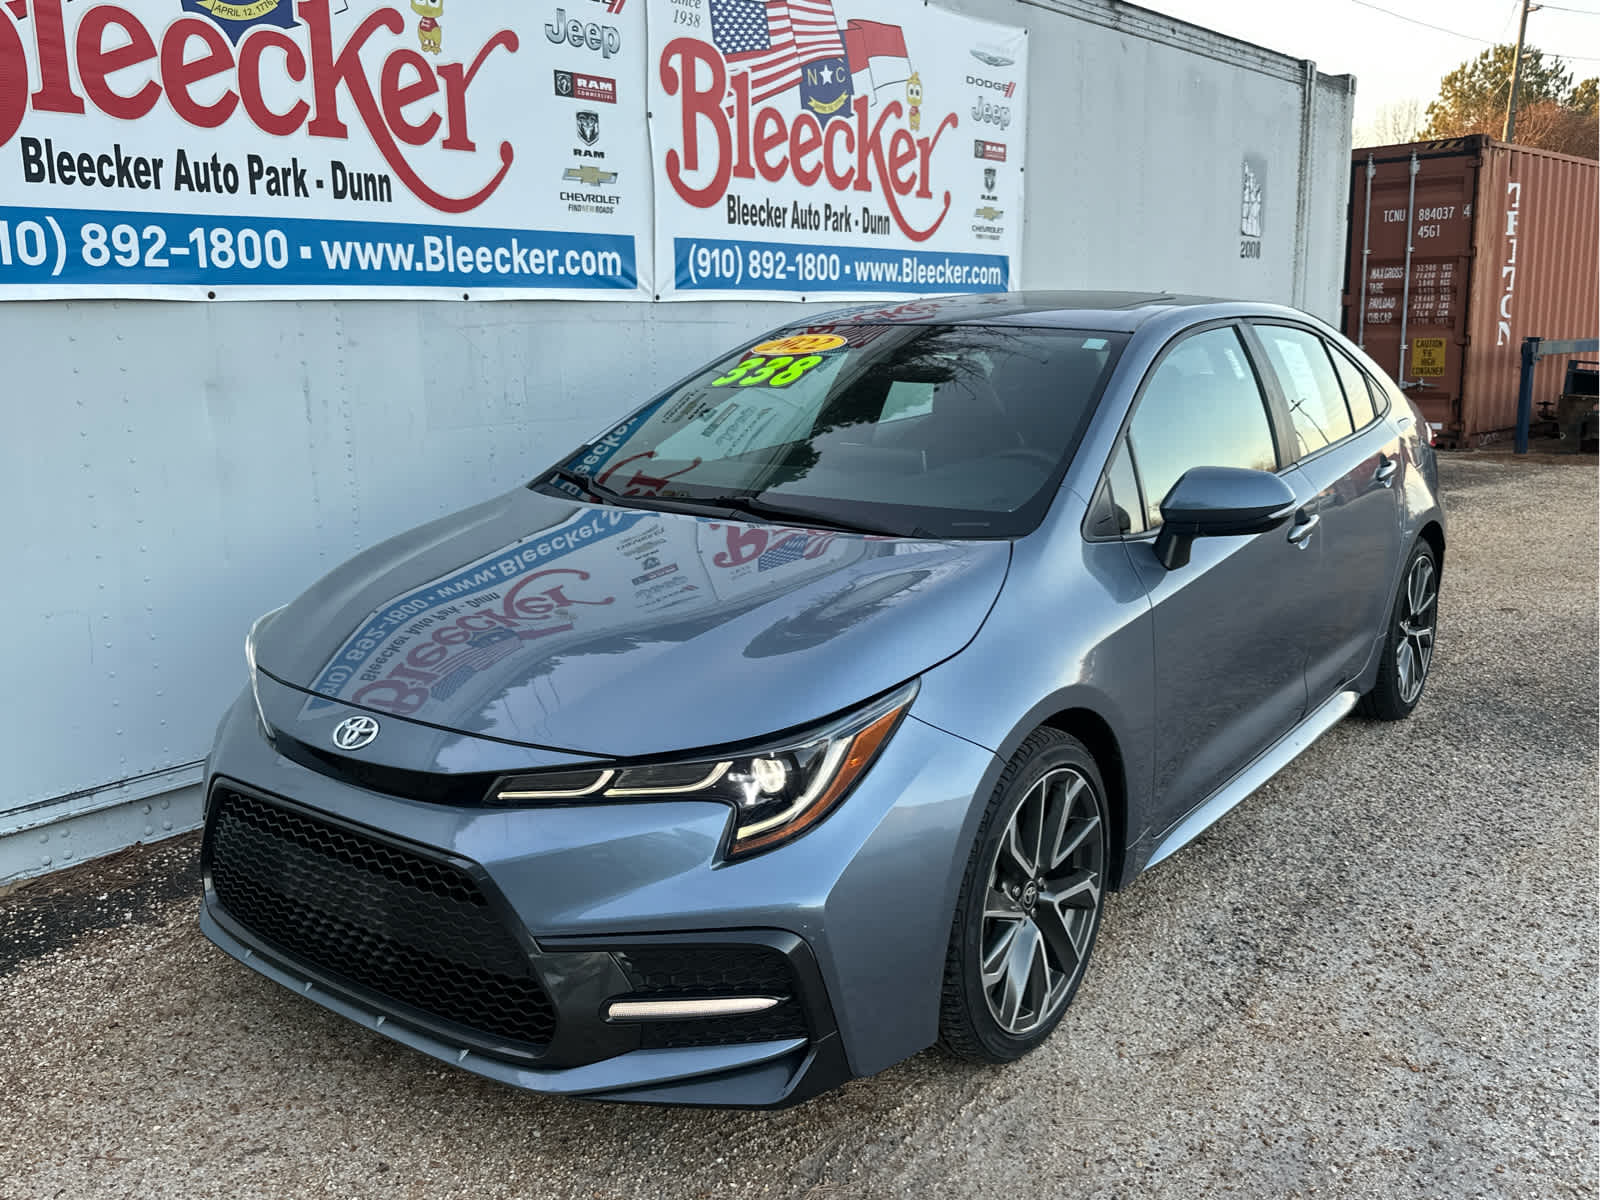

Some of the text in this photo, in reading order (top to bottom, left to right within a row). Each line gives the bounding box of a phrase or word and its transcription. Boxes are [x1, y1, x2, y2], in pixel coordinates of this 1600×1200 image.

[214, 4, 241, 16] APRIL
[673, 9, 702, 28] 1938
[545, 8, 621, 59] Jeep
[577, 78, 613, 91] RAM
[807, 66, 846, 86] N C
[966, 75, 1009, 92] DODGE
[0, 0, 519, 214] leecker
[971, 96, 1011, 130] Jeep
[660, 37, 958, 242] Bleecker
[986, 144, 1005, 153] RAM
[573, 148, 605, 159] RAM
[20, 136, 393, 202] Bleecker Auto Park Dunn
[559, 191, 622, 206] CHEVROLET
[727, 194, 890, 235] Bleecker Auto Park Dunn
[1384, 204, 1472, 222] TCNU 884037 4
[1418, 225, 1440, 238] 45G1
[80, 222, 289, 270] 892-1800
[320, 236, 622, 277] www.Bleecker.com
[688, 243, 1001, 286] (910) 892-1800 www.Bleecker.com
[711, 356, 823, 387] 338
